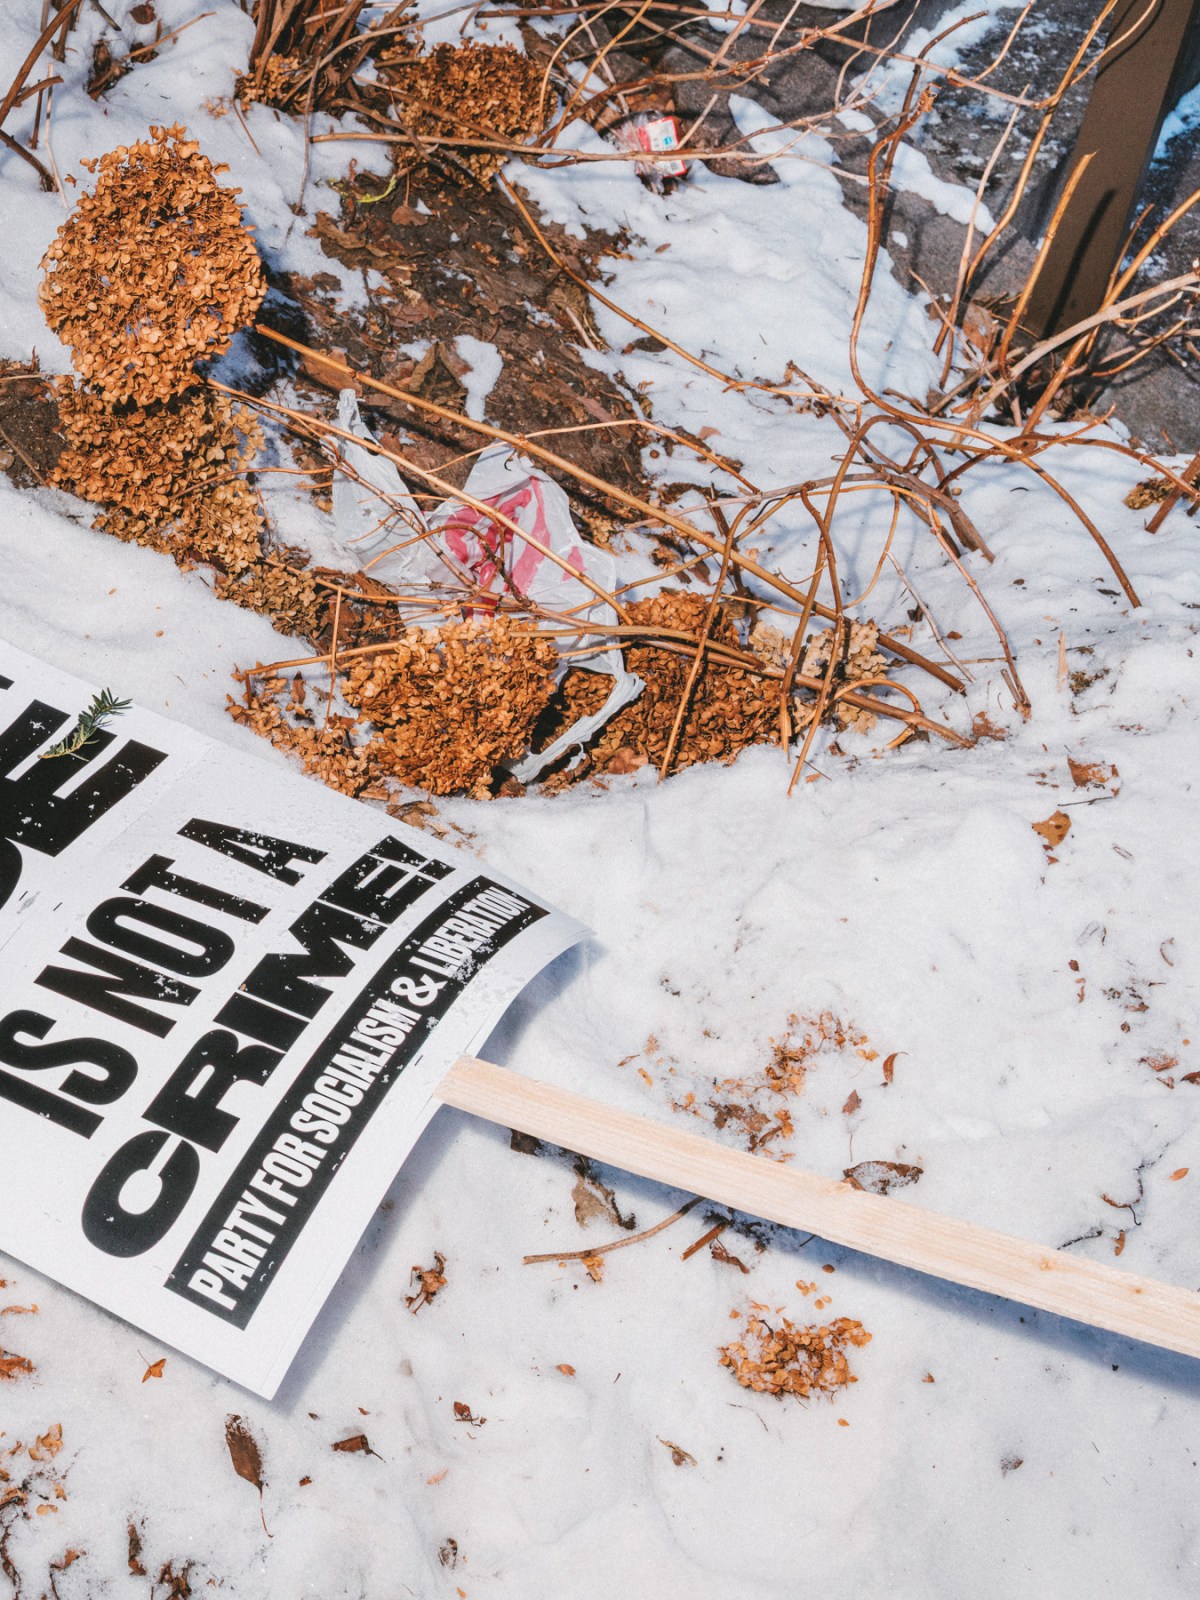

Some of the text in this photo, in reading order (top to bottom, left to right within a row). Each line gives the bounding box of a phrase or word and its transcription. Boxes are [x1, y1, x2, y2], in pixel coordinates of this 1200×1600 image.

[33, 853, 272, 1039] NOT
[177, 817, 330, 886] A
[81, 834, 456, 1258] CRIME!
[187, 886, 531, 1311] PARTY FOR SOCIALISM & LIBERATION
